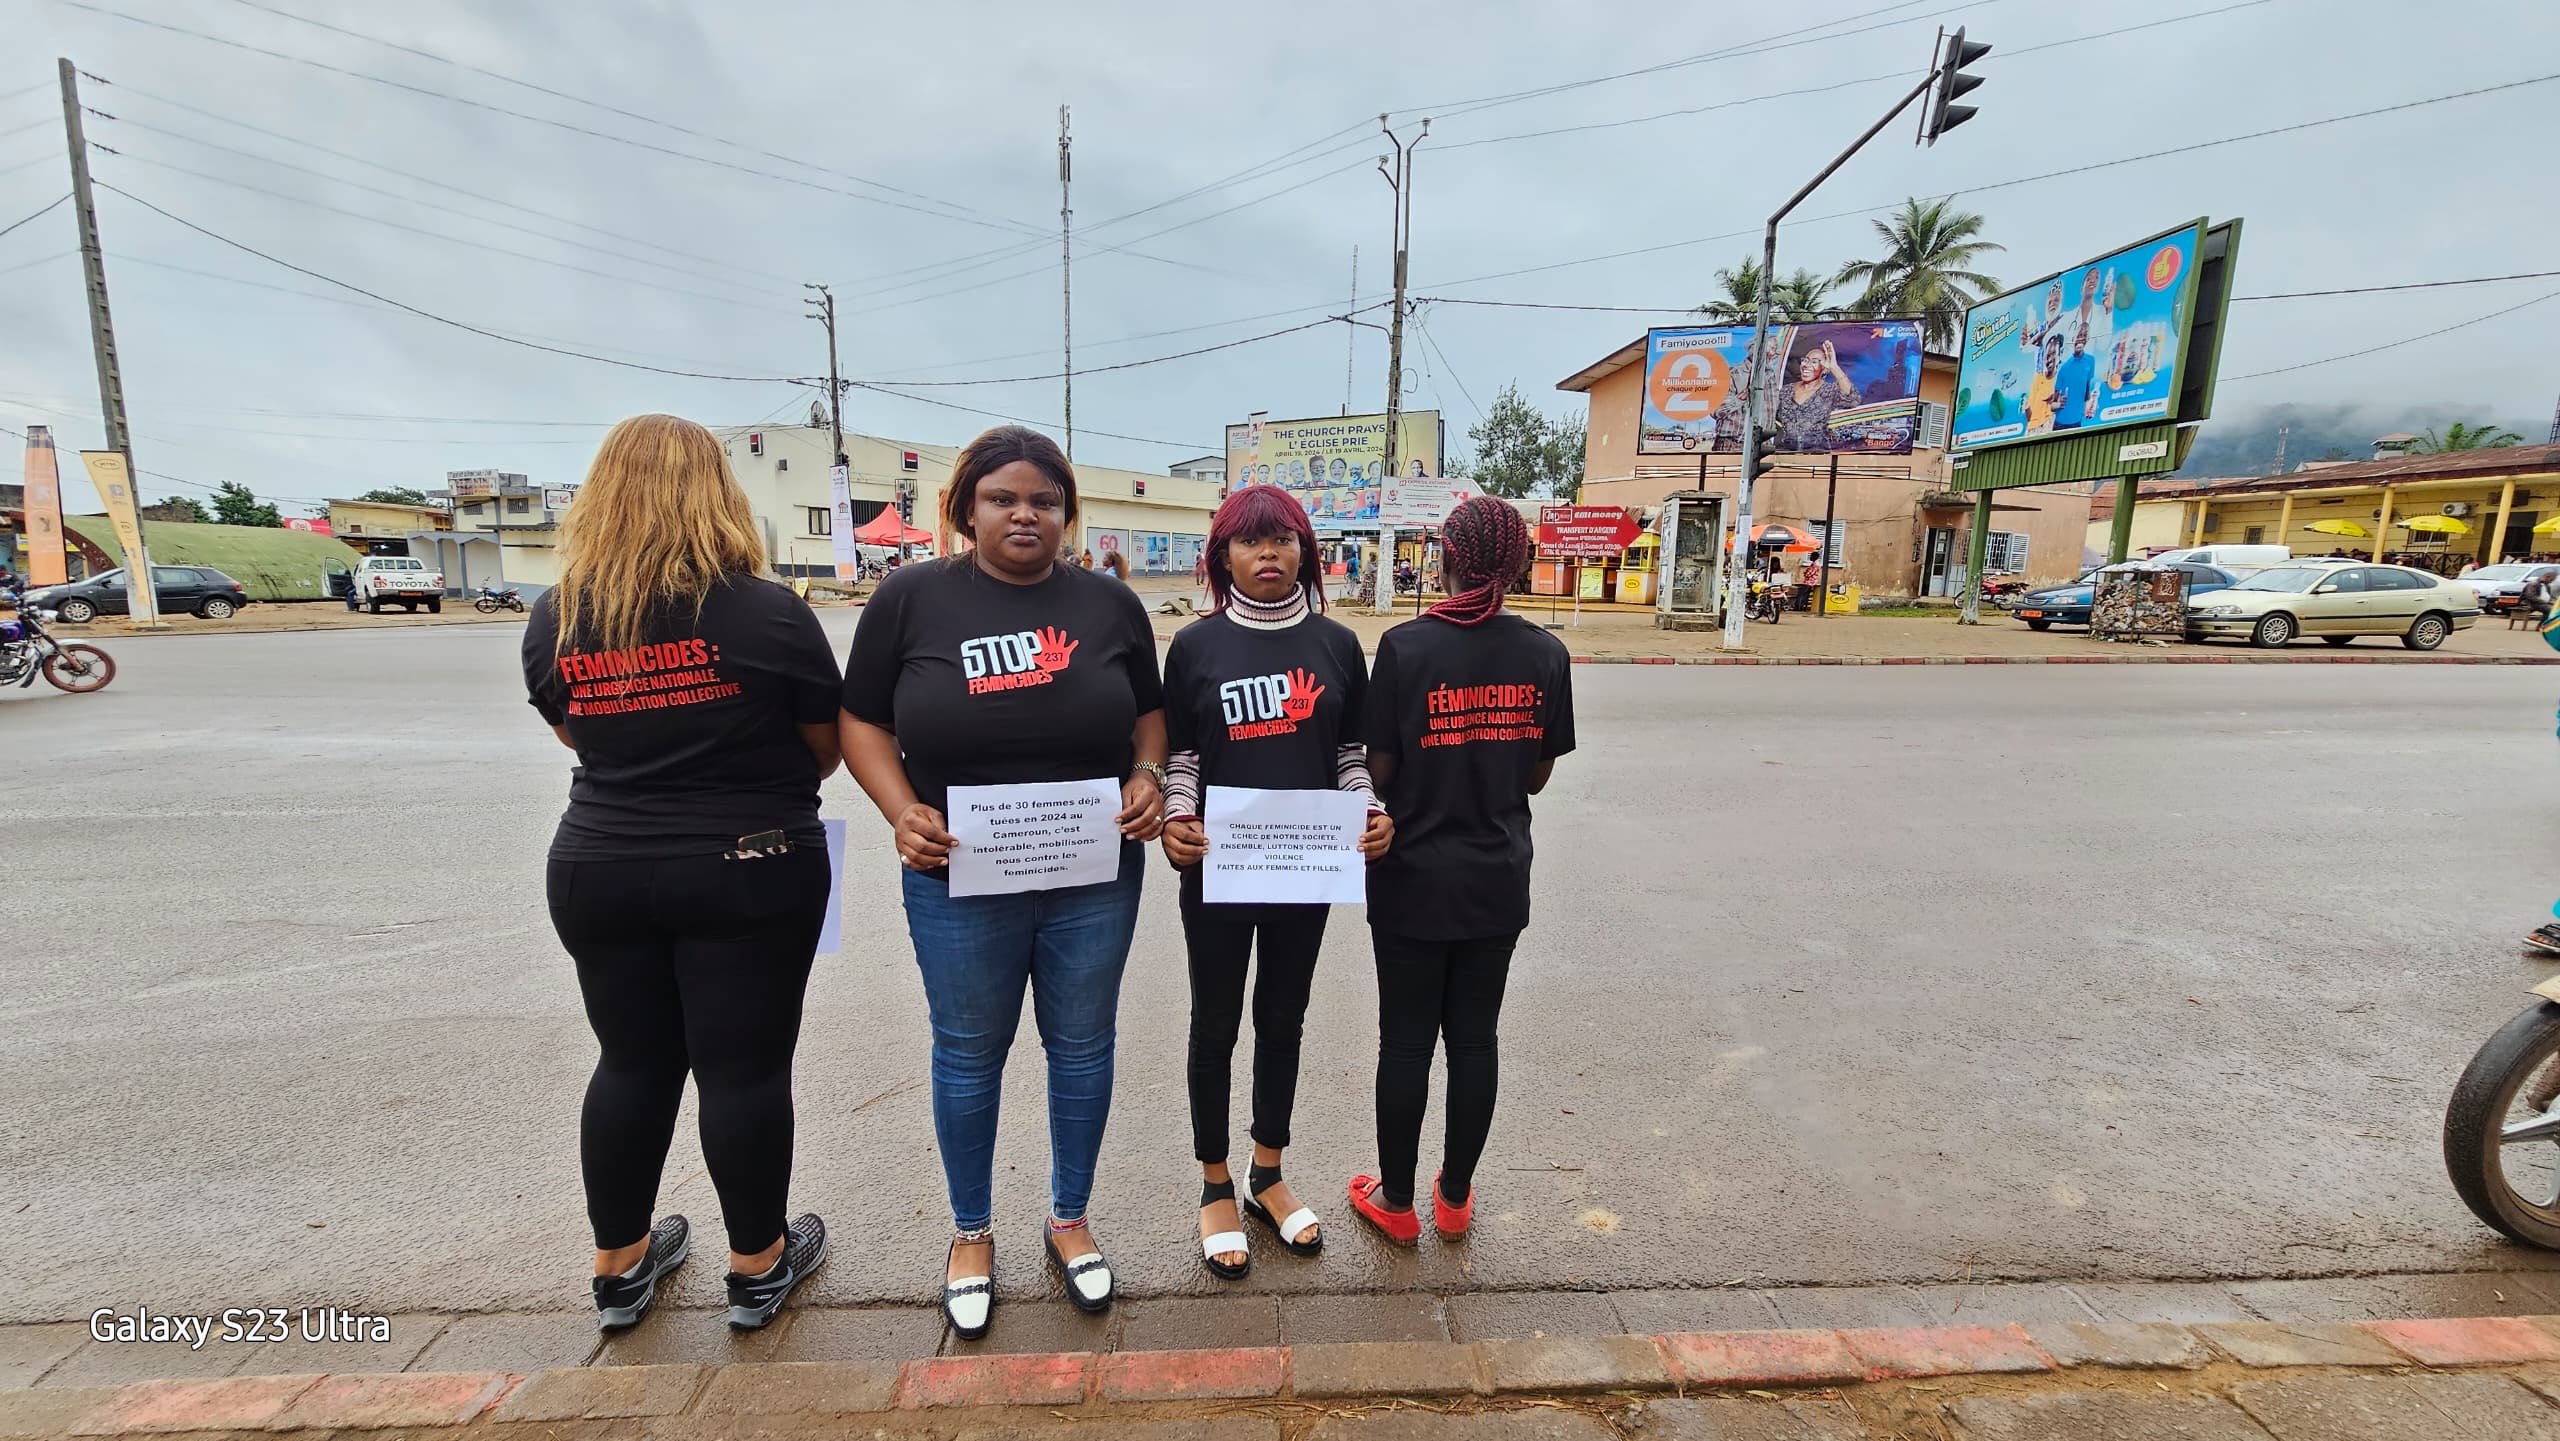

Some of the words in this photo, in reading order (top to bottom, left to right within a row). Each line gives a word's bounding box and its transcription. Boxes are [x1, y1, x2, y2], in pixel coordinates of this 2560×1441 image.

[1660, 335, 1727, 348] Famiyoooo!!!
[1662, 377, 1717, 386] Millionnaires
[1664, 353, 1712, 412] 2
[1666, 385, 1693, 393] chaque
[1273, 430, 1295, 440] THE
[1297, 427, 1345, 438] CHURCH
[1348, 424, 1386, 435] PRAYS
[1300, 438, 1339, 449] ÉGLISE
[1342, 436, 1369, 447] PRIE
[1592, 511, 1623, 520] money
[1556, 526, 1588, 534] TRANSFERT
[1589, 526, 1618, 534] D'ARGENT
[1099, 535, 1119, 551] 60
[559, 638, 709, 683] FÉMINICIDES
[960, 631, 1043, 679] STOP
[1044, 652, 1064, 662] 237
[571, 684, 594, 699] UNE
[594, 677, 651, 698] URGENCE
[651, 668, 721, 690] NATIONALE,
[568, 700, 584, 716] UNE
[583, 693, 668, 716] MOBILISATION
[668, 682, 742, 706] COLLECTIVE
[1219, 673, 1291, 725] STOP
[1291, 698, 1310, 710] 237
[1427, 682, 1536, 714] FÉMINICIDES
[1429, 717, 1451, 730] UNE
[1450, 711, 1487, 730] URENCE
[1420, 734, 1440, 749] UNE
[1440, 727, 1499, 746] MOBISATION
[971, 804, 995, 814] Plus
[998, 803, 1012, 812] de
[1016, 801, 1029, 810] 30
[1032, 798, 1075, 809] femmes
[1041, 812, 1067, 823] 2024
[1070, 812, 1084, 820] au
[993, 828, 1052, 840] Cameroun,
[1054, 825, 1081, 835] c'est
[1229, 823, 1263, 831] CHAQUE
[1329, 824, 1342, 832] UN
[1039, 837, 1100, 850] mobilisons-
[1267, 843, 1304, 851] LUTTONS
[995, 856, 1022, 866] nous
[1024, 852, 1060, 864] contre
[1062, 850, 1078, 860] les
[1265, 864, 1299, 872] FEMMES
[1312, 865, 1342, 873] FILLES.
